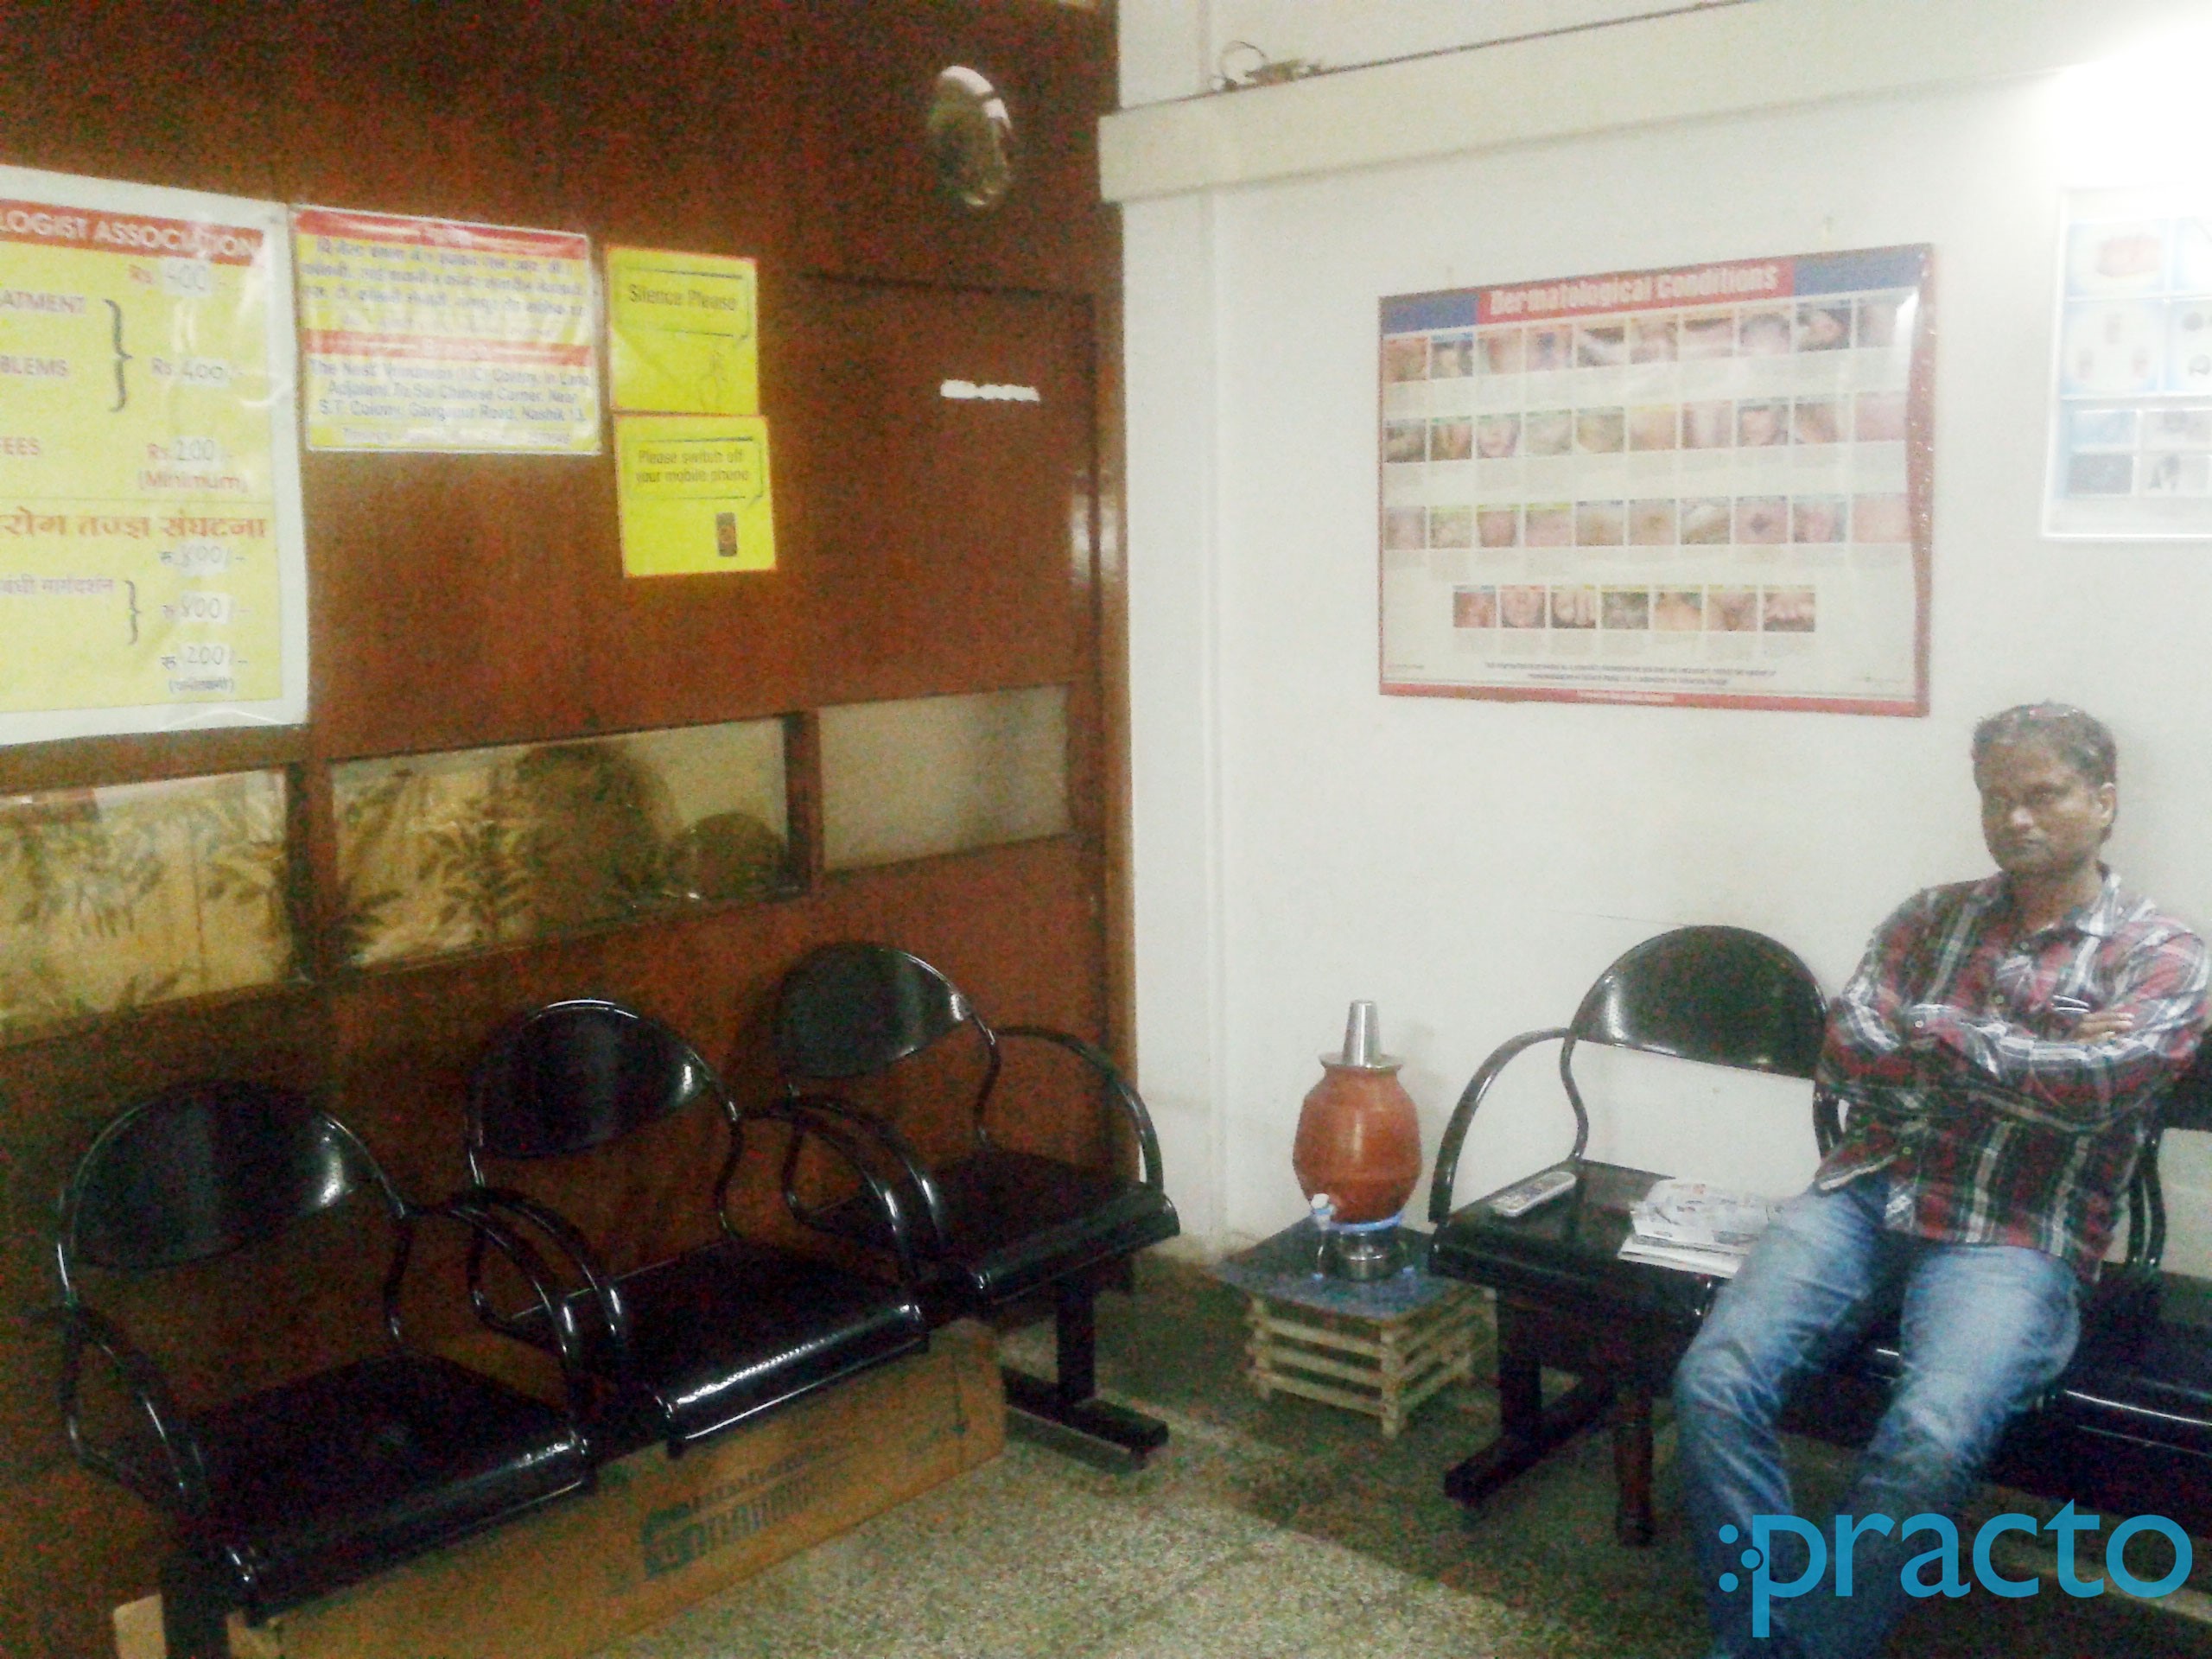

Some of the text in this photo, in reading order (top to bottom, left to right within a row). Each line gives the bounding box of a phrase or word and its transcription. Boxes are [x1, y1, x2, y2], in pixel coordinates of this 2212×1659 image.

[628, 283, 738, 312] Silence Please
[639, 449, 677, 464] Please
